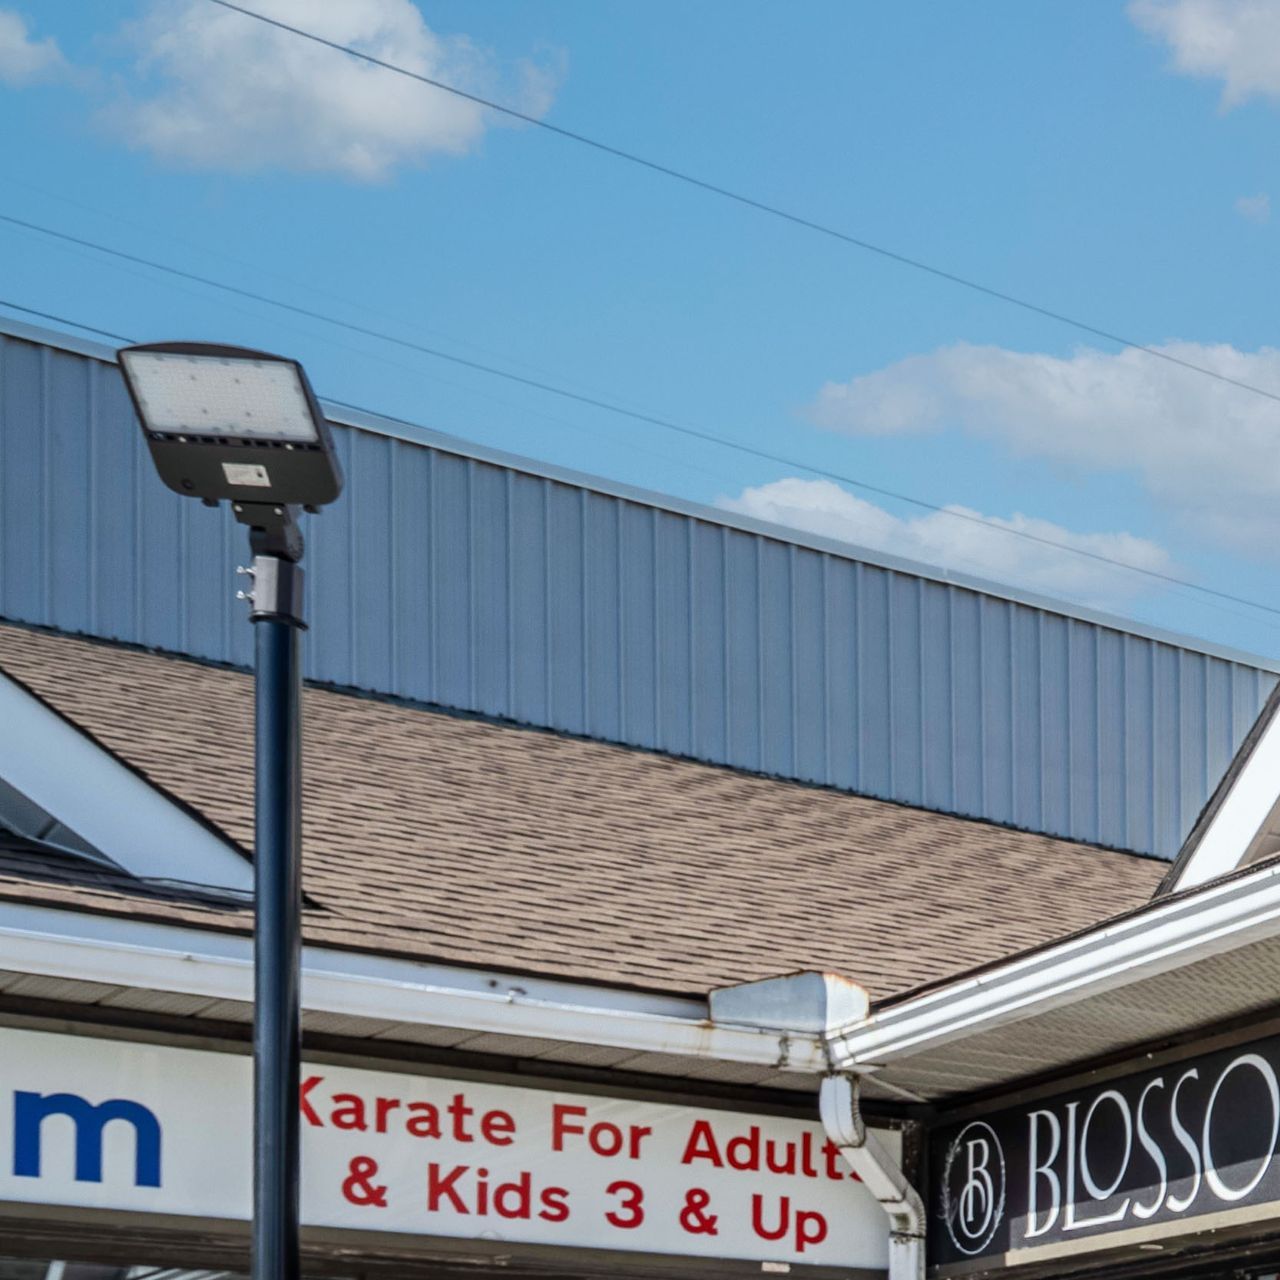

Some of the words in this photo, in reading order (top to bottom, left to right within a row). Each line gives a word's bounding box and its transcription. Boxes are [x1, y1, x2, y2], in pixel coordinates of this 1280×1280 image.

[300, 1075, 516, 1147] Karate
[550, 1104, 653, 1160] For
[341, 1154, 388, 1208] &
[427, 1162, 571, 1224] Kids
[605, 1180, 646, 1230] 3
[678, 1187, 718, 1236] &
[751, 1193, 829, 1253] Up
